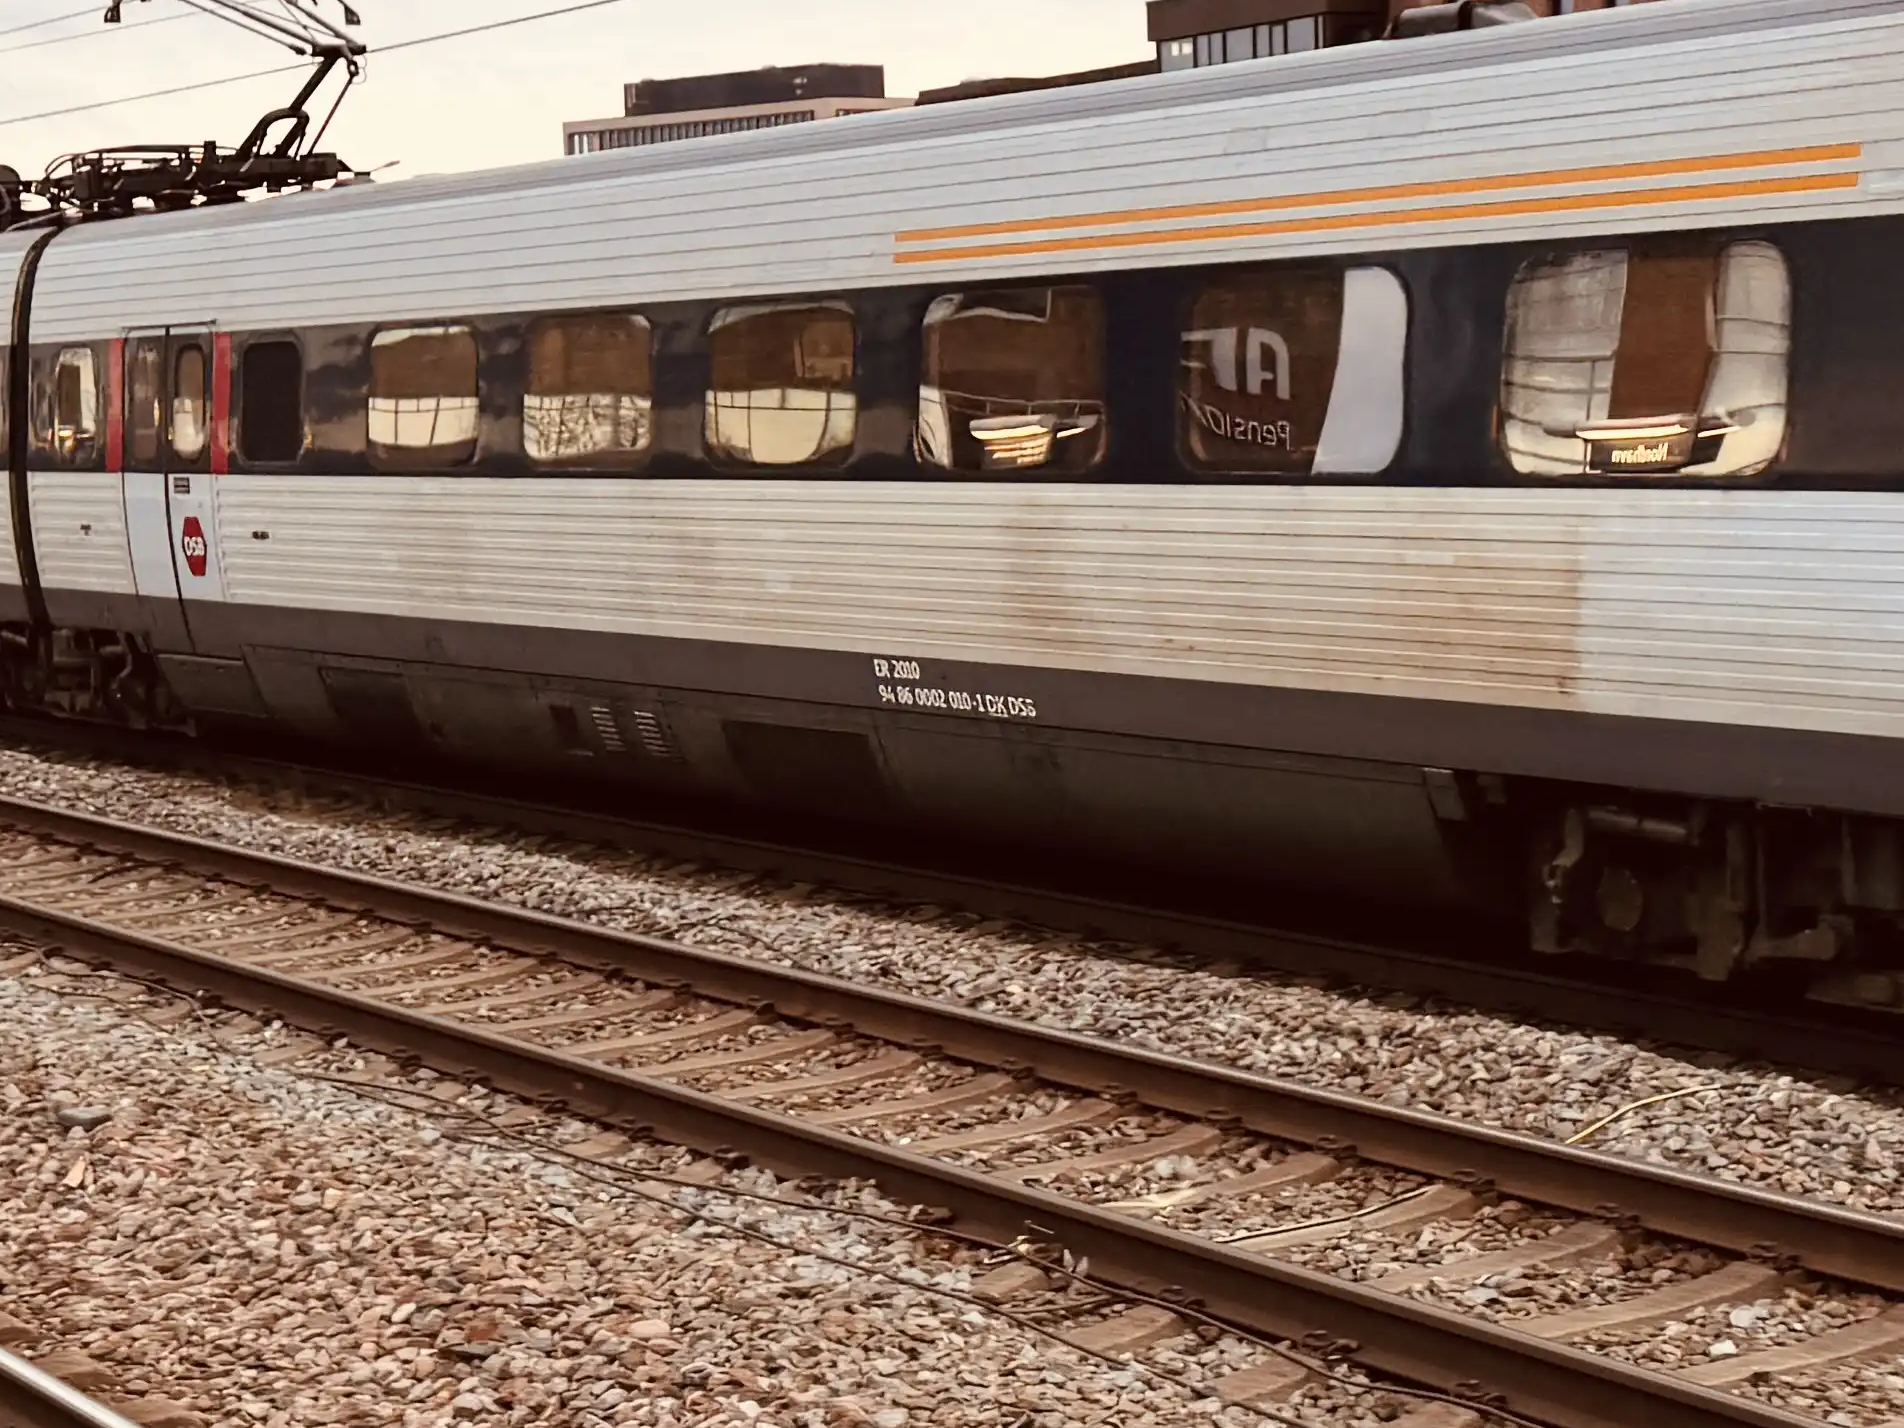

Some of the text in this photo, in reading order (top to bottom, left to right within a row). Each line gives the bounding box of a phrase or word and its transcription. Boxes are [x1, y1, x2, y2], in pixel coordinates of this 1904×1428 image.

[184, 536, 205, 557] DSB
[873, 658, 920, 680] ER 2010
[896, 686, 914, 705] 86
[914, 688, 947, 708] 0002
[985, 694, 1009, 716] DK
